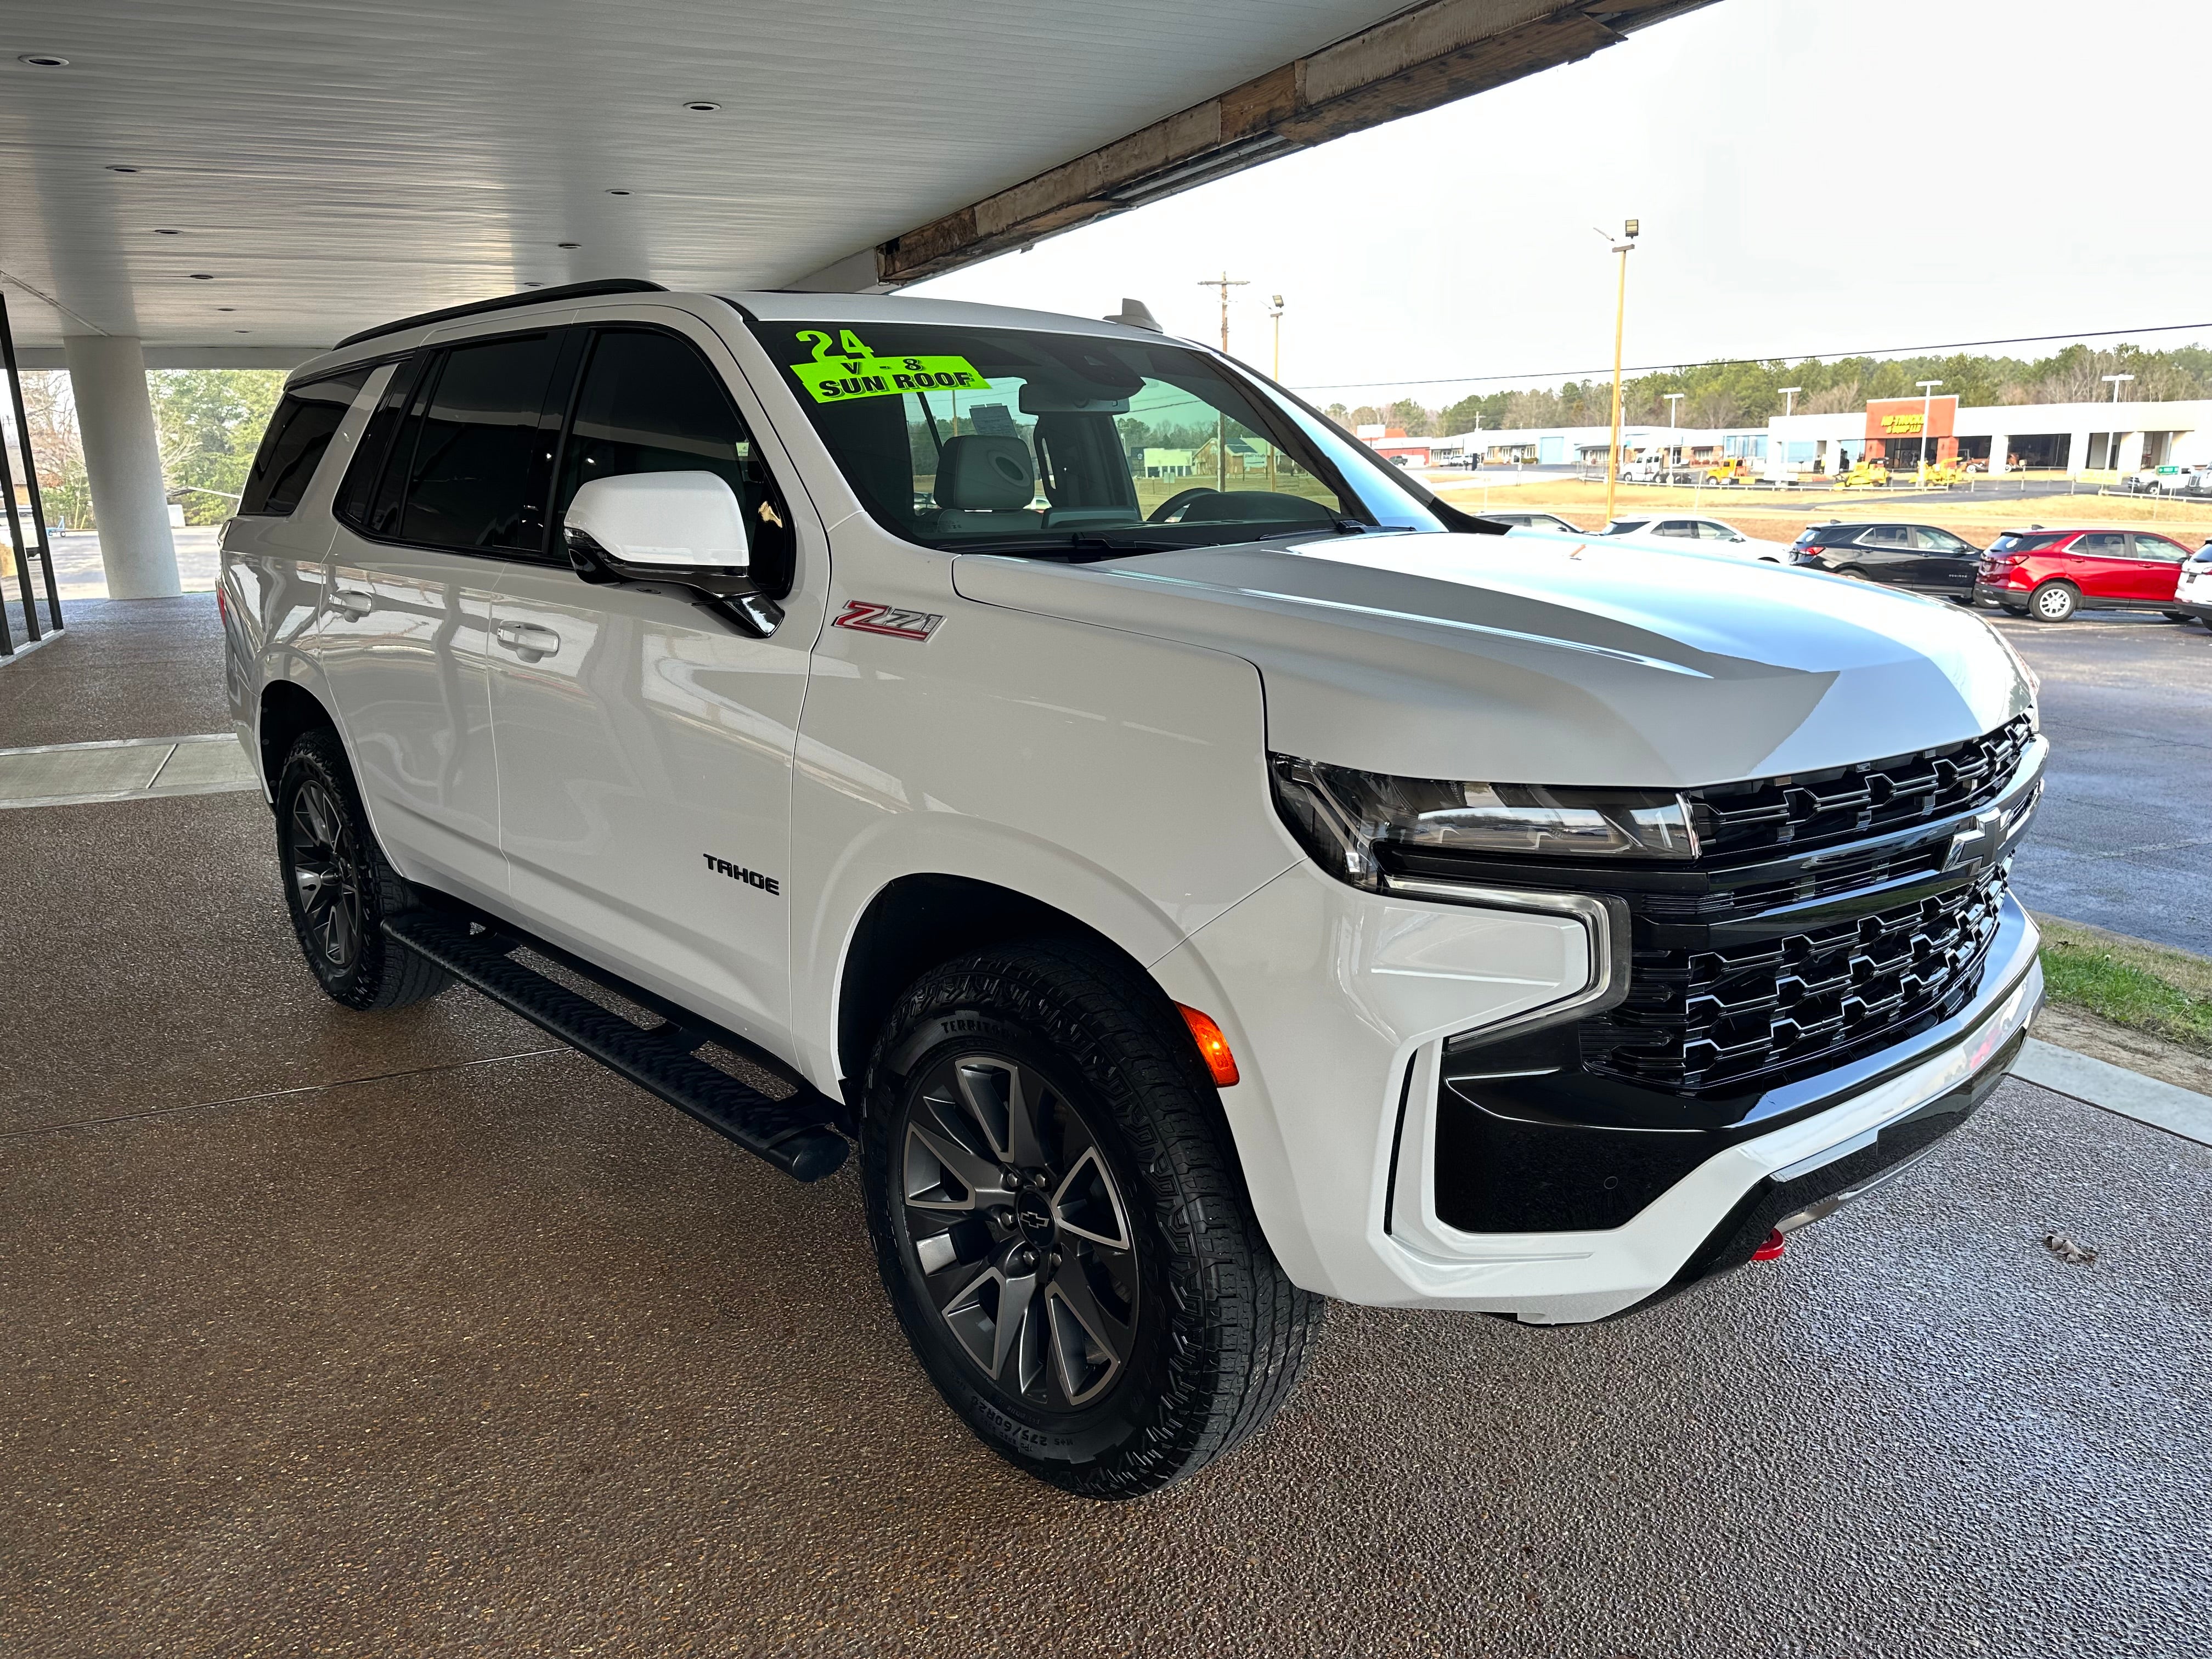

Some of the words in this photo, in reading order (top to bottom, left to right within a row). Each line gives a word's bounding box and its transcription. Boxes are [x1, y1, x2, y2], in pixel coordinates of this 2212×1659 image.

[795, 330, 874, 363] 24
[819, 375, 888, 397] SUN
[892, 371, 975, 390] ROOF
[831, 600, 948, 643] Z71
[703, 853, 780, 896] TAHOE
[970, 1395, 1048, 1447] 275/60R20
